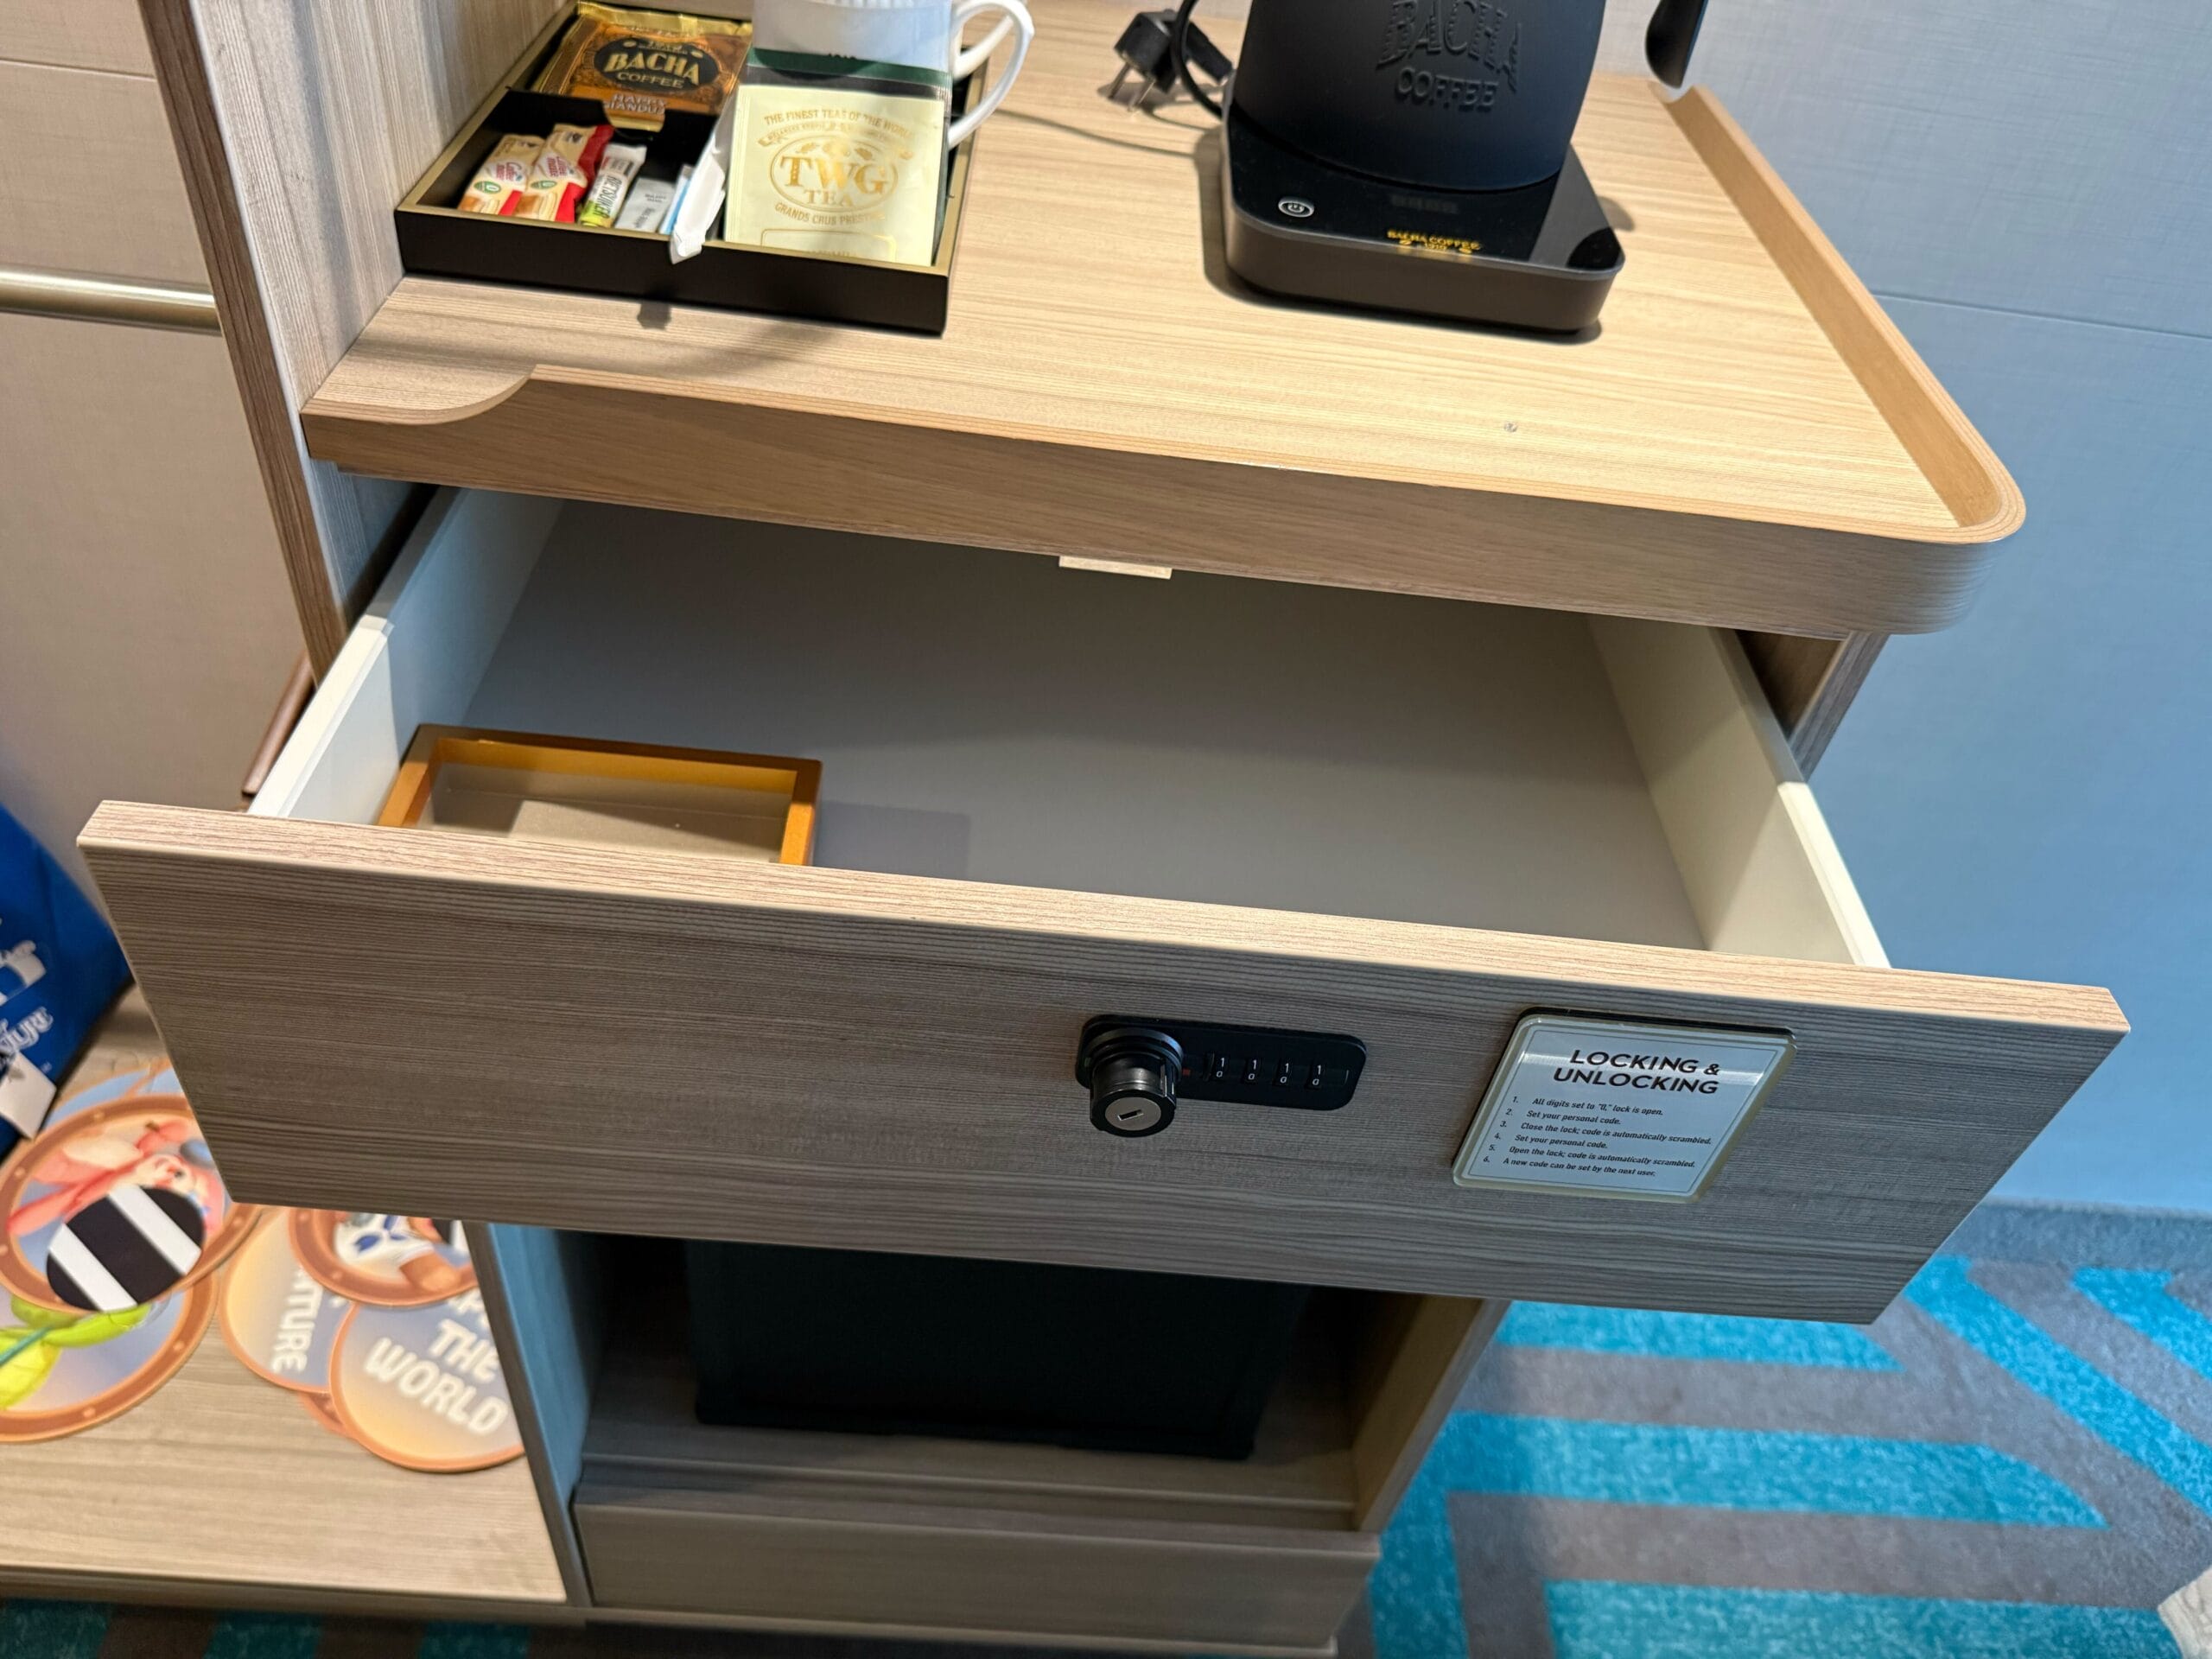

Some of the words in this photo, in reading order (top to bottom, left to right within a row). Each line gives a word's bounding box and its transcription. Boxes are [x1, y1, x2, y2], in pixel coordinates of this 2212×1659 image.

[603, 52, 700, 86] BACHA
[617, 72, 684, 88] COFFEE
[1397, 67, 1499, 111] COFFEE
[764, 113, 785, 126] THE
[786, 110, 819, 120] FINEST
[779, 155, 890, 195] TWG
[804, 189, 855, 207] TEA
[774, 201, 810, 224] GRANDS
[1570, 1049, 1699, 1073] LOCKING
[1703, 1063, 1720, 1076] &
[1554, 1067, 1719, 1095] UNLOCKING
[1527, 1109, 1541, 1118] Set
[1562, 1113, 1598, 1123] personal
[1532, 1097, 1545, 1106] All
[1546, 1099, 1570, 1109] digits
[1612, 1104, 1631, 1114] lock
[1632, 1105, 1640, 1114] is
[1494, 1132, 1501, 1141] 4.
[1515, 1134, 1529, 1142] Set
[1549, 1138, 1586, 1147] personal
[1586, 1140, 1608, 1149] code.
[1521, 1122, 1543, 1131] Close
[1545, 1124, 1559, 1133] the
[1581, 1127, 1602, 1135] code
[1611, 1129, 1668, 1142] automatically
[1668, 1135, 1712, 1145] scrambled.
[1509, 1146, 1529, 1154] Open
[1597, 1154, 1652, 1166] automatically
[1652, 1158, 1695, 1168] scrambled.
[1592, 1165, 1602, 1173] by
[1604, 1165, 1617, 1173] the
[430, 1319, 499, 1381] THE
[363, 1337, 509, 1436] WORLD
